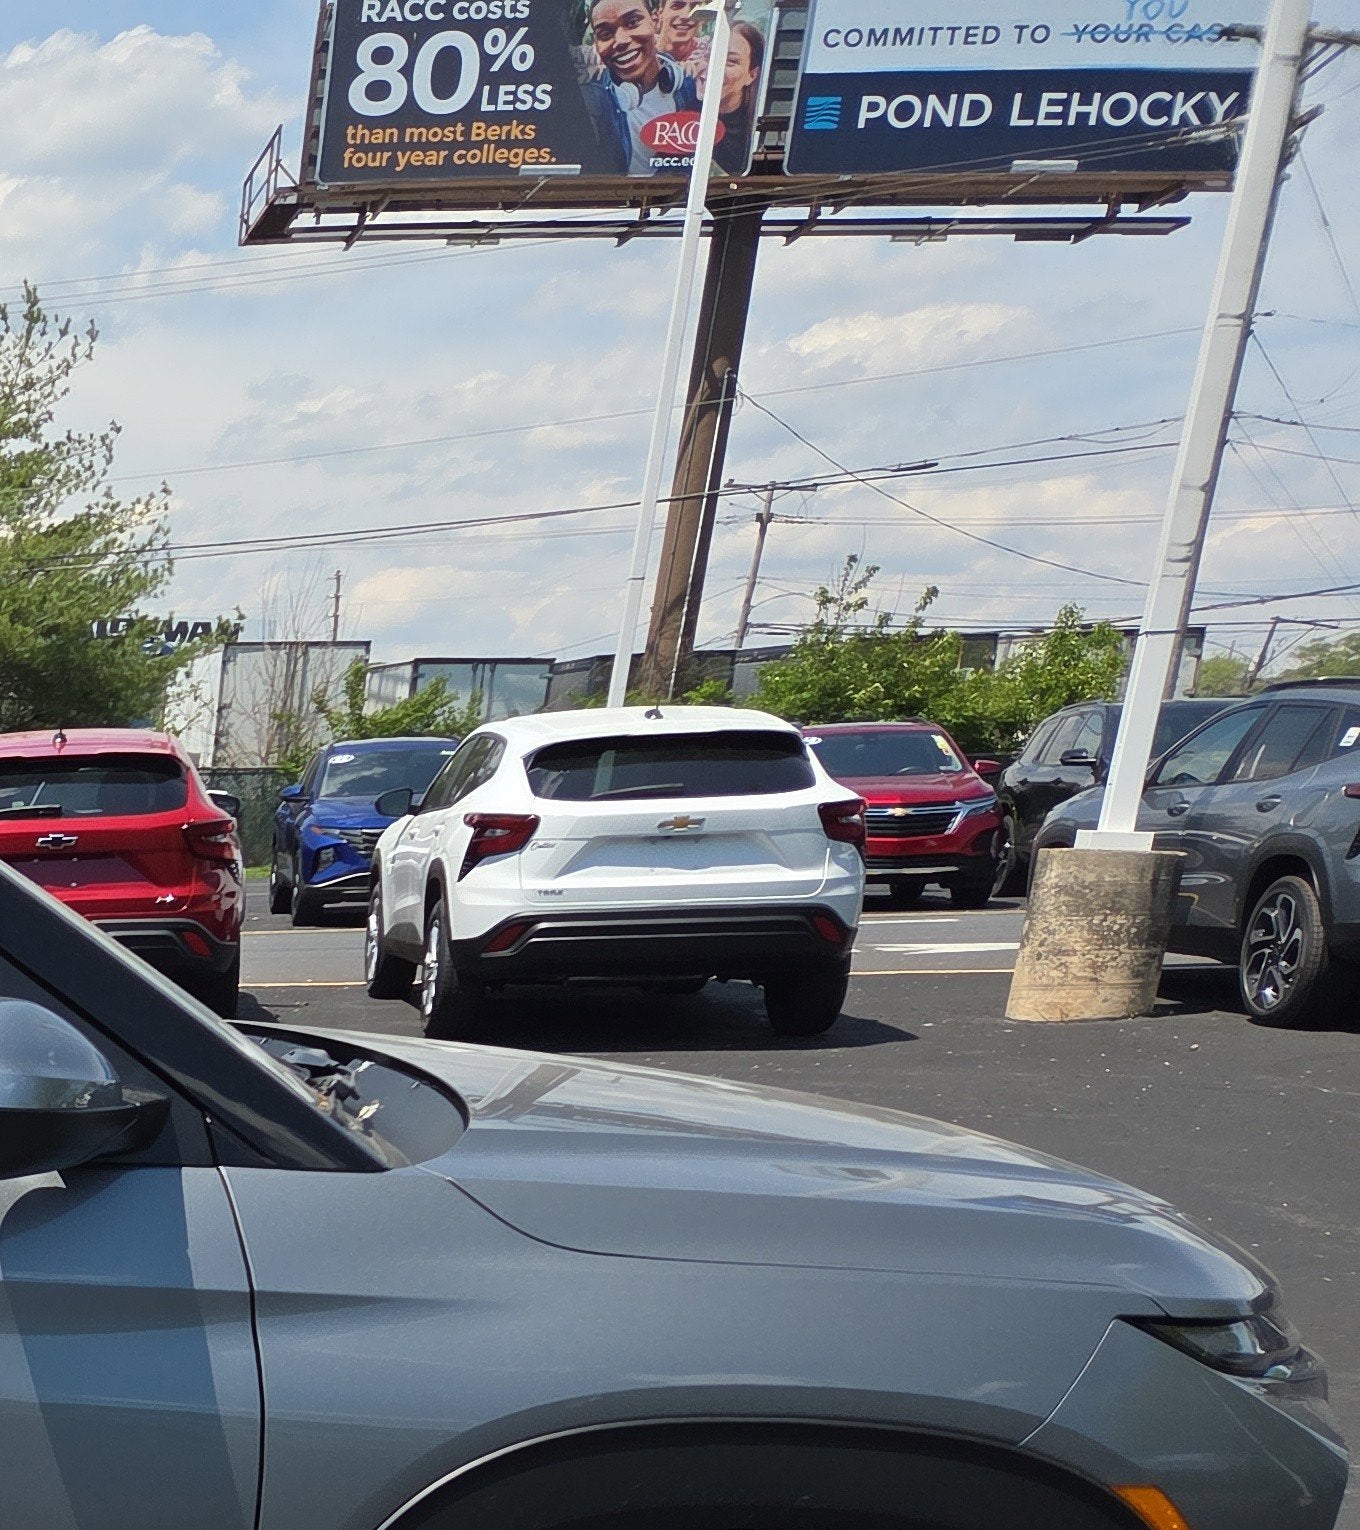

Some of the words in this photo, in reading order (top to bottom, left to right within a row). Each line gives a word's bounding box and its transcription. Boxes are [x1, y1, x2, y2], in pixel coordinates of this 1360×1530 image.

[361, 0, 445, 22] RACC
[452, 0, 530, 20] costs
[1126, 0, 1188, 20] YOU
[823, 25, 1001, 48] COMMITTED
[1014, 24, 1051, 44] TO
[1072, 22, 1156, 44] YOUR
[481, 83, 553, 112] LESS
[857, 93, 993, 129] POND
[1009, 91, 1240, 127] LEHOCKY
[346, 124, 398, 144] than
[404, 121, 465, 143] most
[470, 119, 536, 141] Berks
[343, 147, 392, 168] four
[395, 146, 448, 171] year
[453, 143, 557, 168] colleges.
